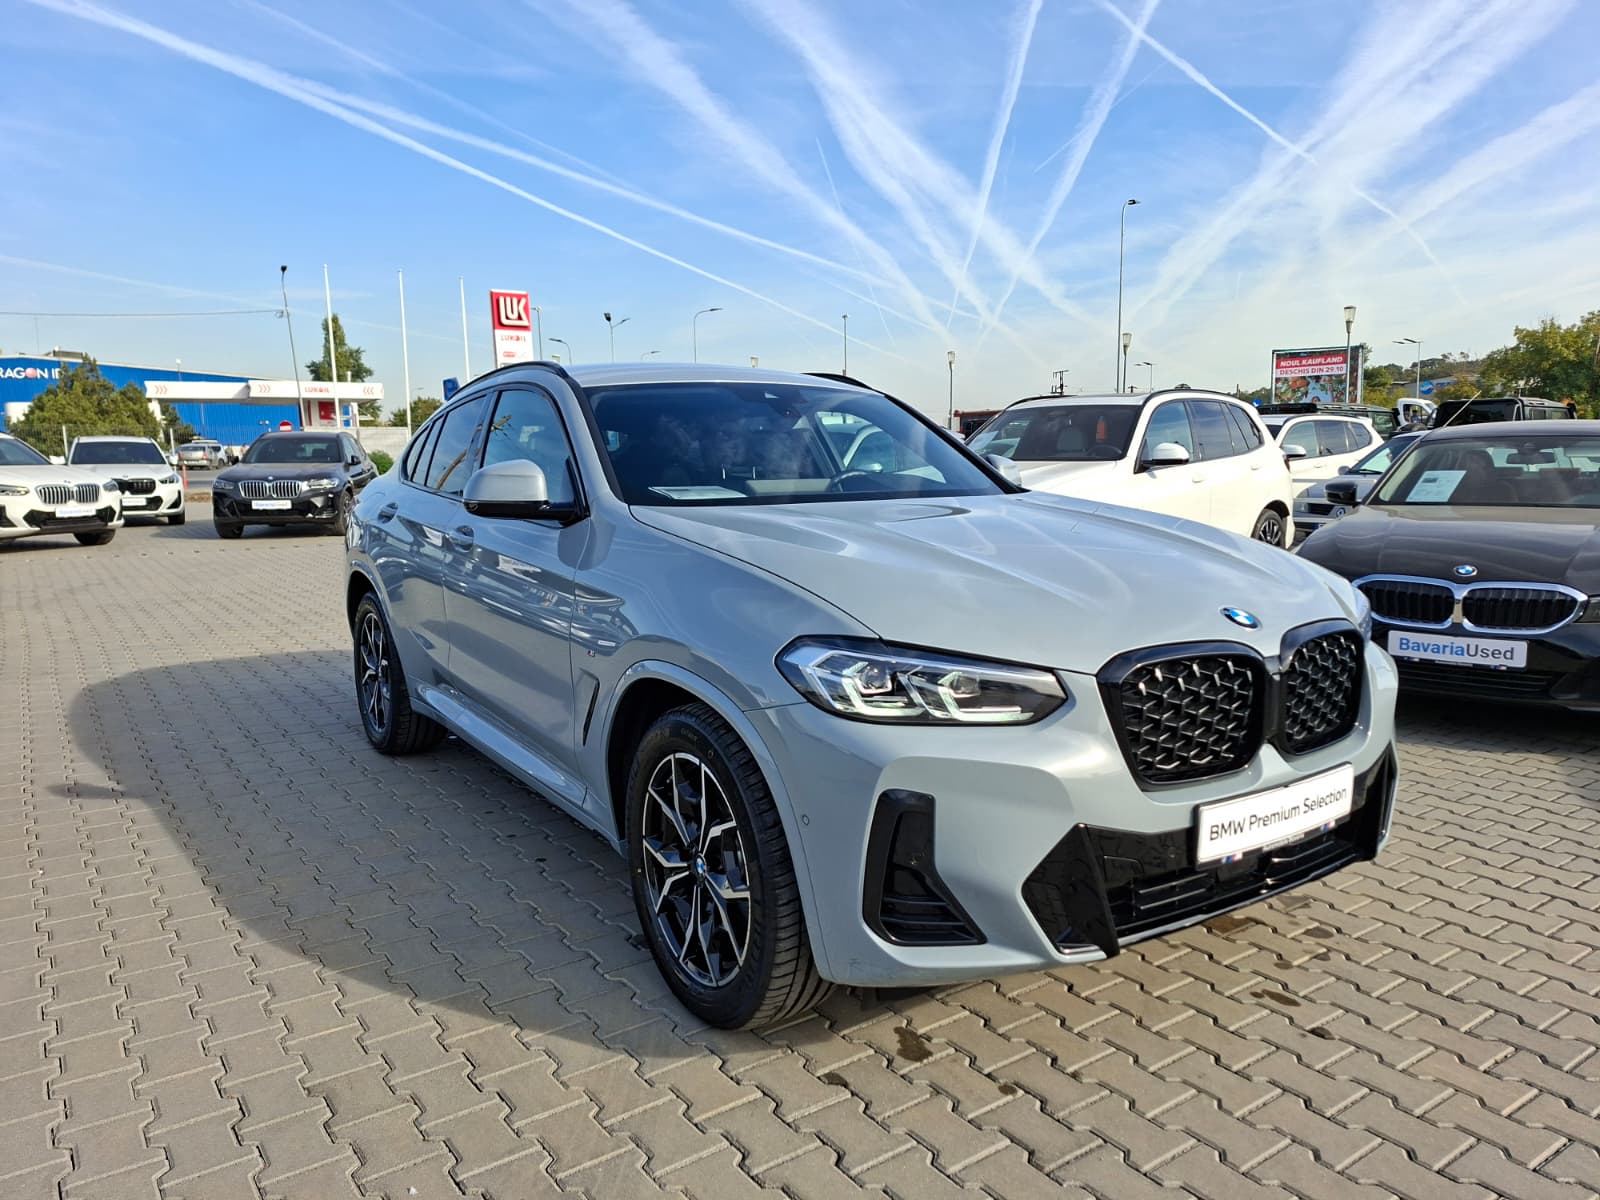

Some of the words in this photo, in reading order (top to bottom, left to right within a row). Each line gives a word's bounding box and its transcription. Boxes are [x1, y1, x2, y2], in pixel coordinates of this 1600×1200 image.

[1301, 356, 1343, 365] KAUFLAND
[1399, 637, 1514, 660] BavariaUsed
[1209, 815, 1246, 841] BMW
[1249, 804, 1301, 831] Premium
[1303, 787, 1347, 814] Selection
